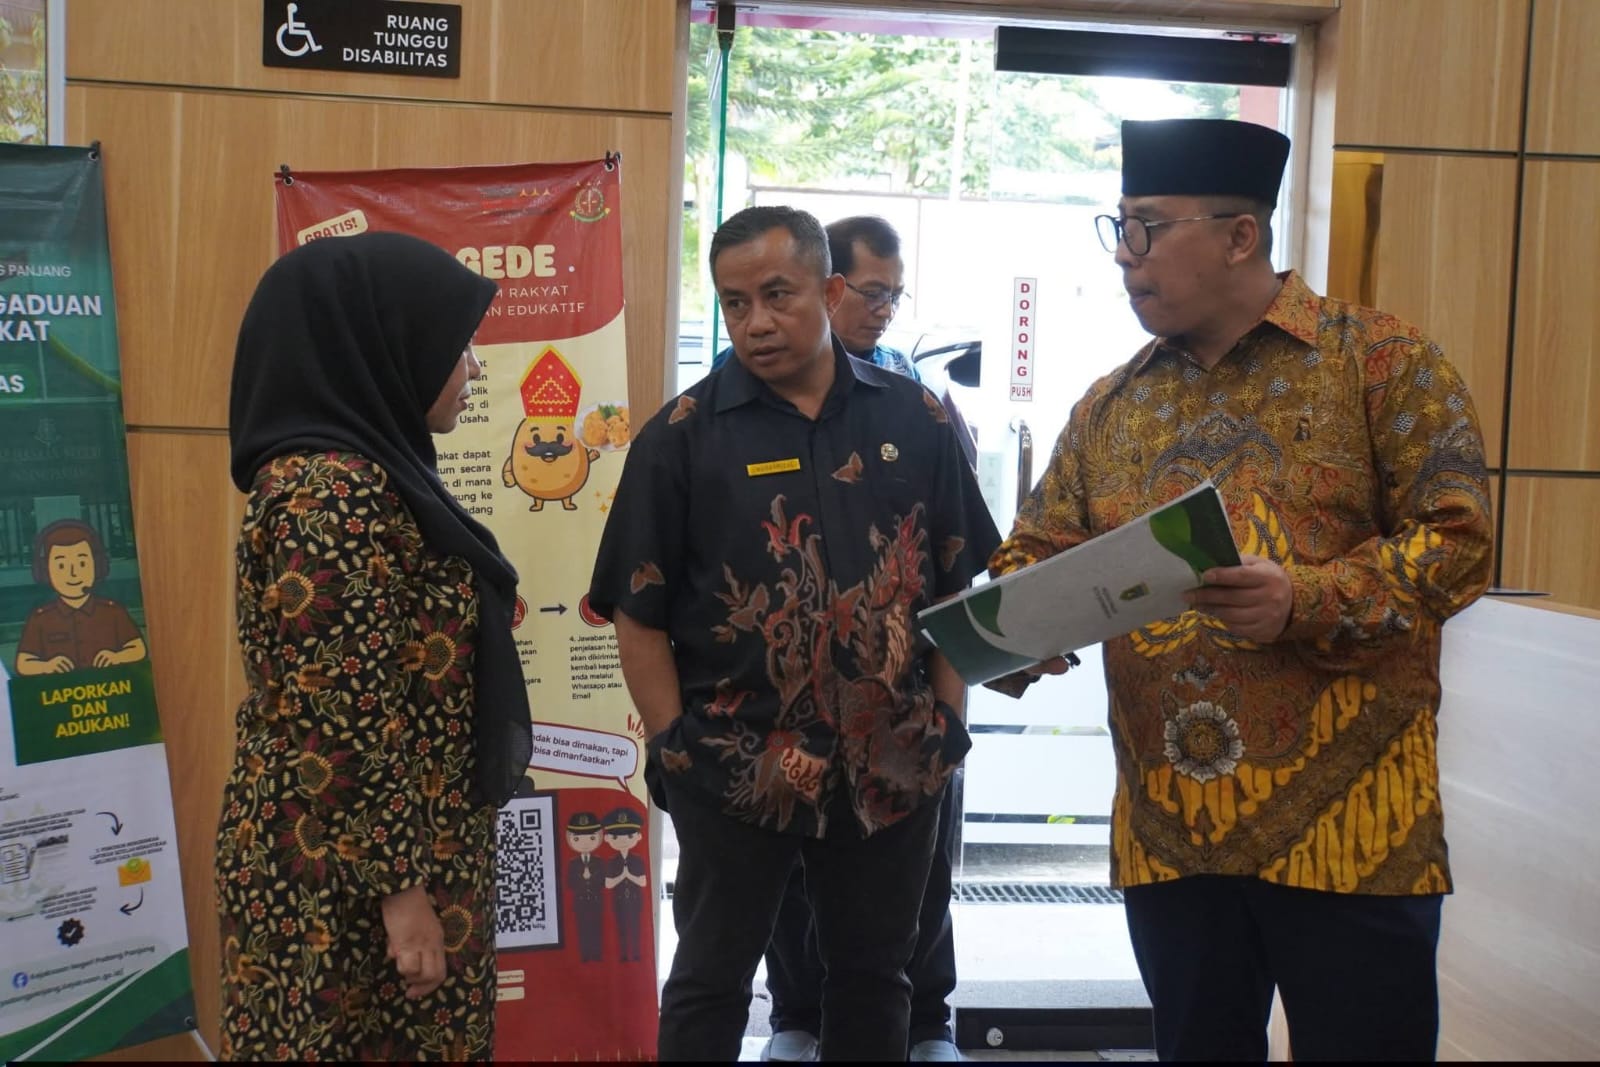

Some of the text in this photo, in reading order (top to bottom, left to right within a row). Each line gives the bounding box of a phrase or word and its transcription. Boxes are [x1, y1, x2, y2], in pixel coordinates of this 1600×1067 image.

[386, 14, 448, 31] RUANG
[374, 32, 448, 49] TUNGGU
[342, 48, 448, 68] DISABILITAS
[304, 217, 358, 243] GRATIS!
[8, 264, 72, 277] PANJANG
[509, 285, 568, 298] RAKYAT
[508, 302, 586, 316] EDUKATIF
[1016, 282, 1030, 377] DORONG
[471, 386, 488, 395] blik
[1011, 386, 1031, 397] PUSH
[480, 400, 489, 409] di
[459, 415, 490, 424] Usaha
[462, 450, 492, 460] dapat
[460, 464, 492, 473] secara
[452, 478, 462, 487] di
[465, 478, 492, 487] mana
[482, 491, 493, 500] ke
[577, 634, 607, 642] Jawaban
[570, 644, 606, 653] penjelasan
[588, 653, 620, 661] dikirimka
[571, 664, 598, 672] kembali
[571, 672, 614, 681] anda melalui
[572, 681, 622, 691] Whatsapp atau
[41, 680, 132, 706] LAPORKAN
[72, 700, 108, 718] DAN
[56, 713, 130, 738] ADUKAN!
[534, 747, 552, 756] bisa
[552, 737, 570, 747] bisa
[572, 740, 610, 754] dimakan,
[612, 747, 628, 758] tapi
